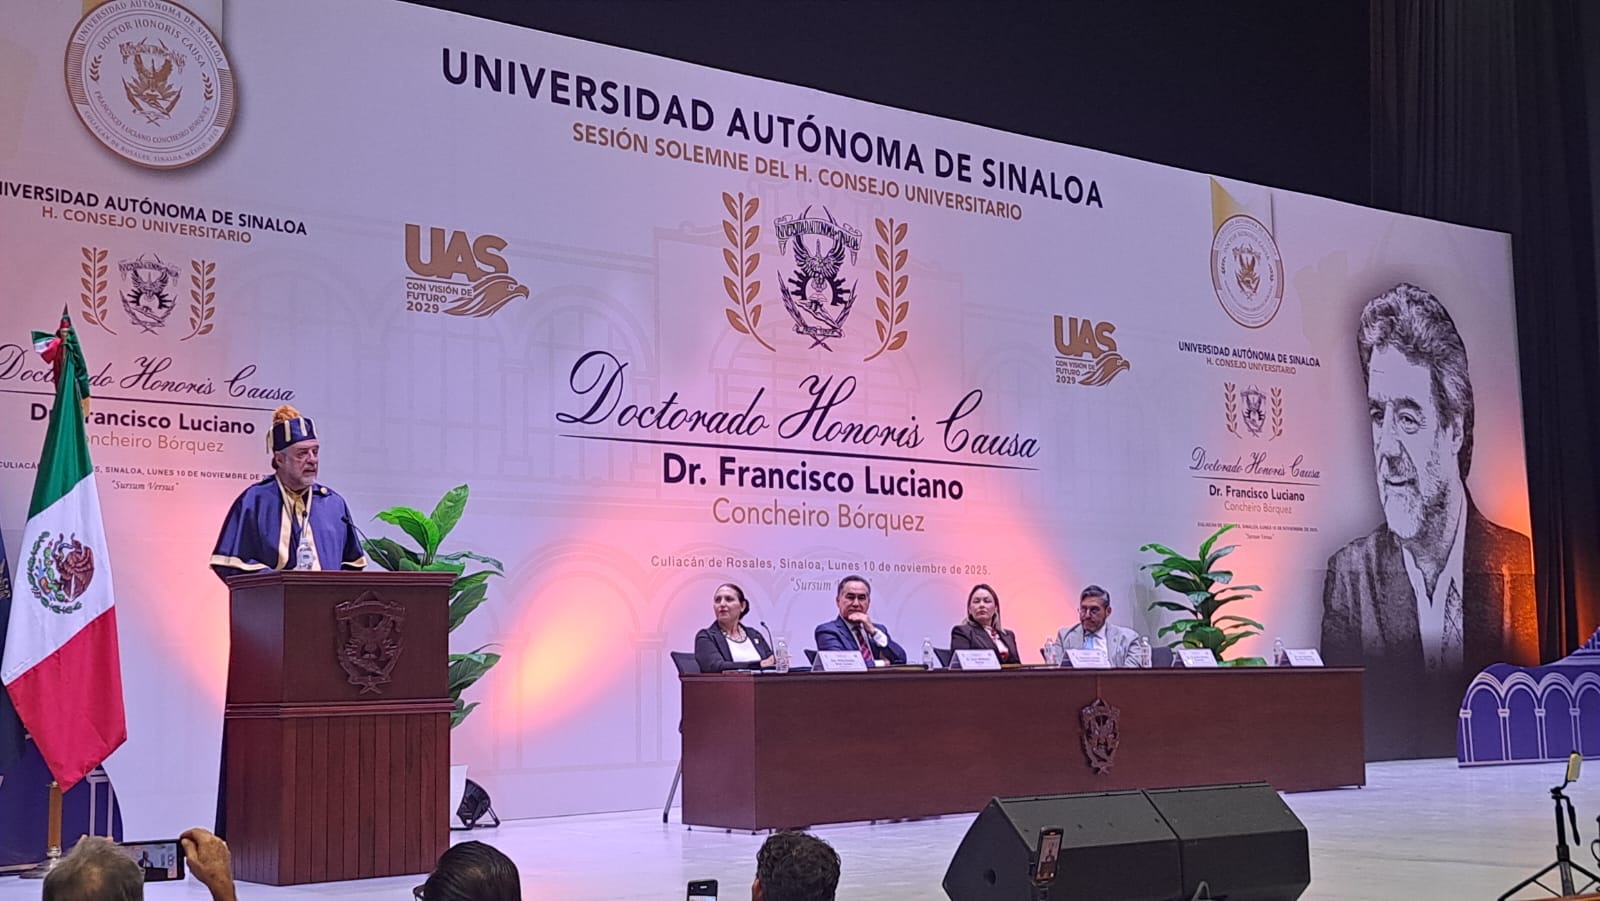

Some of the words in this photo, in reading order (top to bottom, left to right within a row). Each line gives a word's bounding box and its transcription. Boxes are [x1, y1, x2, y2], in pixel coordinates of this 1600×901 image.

[184, 16, 196, 27] DE
[98, 22, 132, 50] DOCTOR
[134, 19, 181, 39] HONORIS
[181, 37, 206, 68] CAUSA
[442, 47, 714, 132] UNIVERSIDAD
[726, 107, 925, 175] AUTÓNOMA
[935, 148, 972, 183] DE
[982, 158, 1104, 209] SINALOA
[572, 122, 649, 154] SESIÓN
[655, 138, 749, 172] SOLEMNE
[755, 156, 790, 180] DEL
[795, 164, 813, 183] H.
[818, 168, 900, 198] CONSEJO
[904, 184, 1023, 221] UNIVERSITARIO
[0, 181, 100, 207] IVERSIDAD
[104, 195, 207, 223] AUTÓNOMA
[212, 210, 233, 226] DE
[238, 213, 307, 236] SINALOA
[42, 206, 58, 219] H.
[63, 208, 137, 229] CONSEJO
[142, 218, 252, 244] UNIVERSITARIO
[405, 223, 509, 283] UAS
[406, 281, 427, 291] CON
[428, 283, 459, 295] VISIÓN
[461, 288, 473, 297] DE
[406, 291, 447, 304] FUTURO
[406, 301, 440, 314] 2029
[1054, 315, 1117, 359] UAS
[1178, 341, 1230, 357] UNIVERSIDAD
[1232, 347, 1276, 362] AUTÓNOMA
[1277, 353, 1288, 364] DE
[1289, 354, 1320, 368] SINALOA
[1215, 358, 1247, 369] CONSEJO
[1248, 362, 1296, 375] UNIVERSITARIO
[0, 344, 114, 387] Doctdo
[120, 356, 216, 394] Honoris
[224, 364, 296, 401] Causa
[1056, 367, 1081, 376] FUTURO
[556, 350, 770, 436] Doctorado
[778, 374, 925, 449] Honoris
[936, 389, 1041, 458] Causa
[84, 408, 171, 429] rancisco
[179, 413, 255, 435] Luciano
[87, 431, 152, 449] ncheiro
[158, 433, 224, 454] Bórquez
[147, 468, 174, 476] LUNES
[188, 470, 198, 478] DE
[200, 471, 247, 480] NOVIEMBRE
[1189, 446, 1243, 473] Doctorado
[1245, 452, 1285, 477] Honoris
[1289, 454, 1320, 479] Causa
[663, 453, 707, 486] Dr.
[719, 456, 855, 493] Francisco
[865, 465, 964, 500] Luciano
[1209, 484, 1223, 497] Dr.
[1226, 485, 1269, 500] Francisco
[1271, 488, 1305, 501] Luciano
[712, 497, 830, 528] Concheiro
[837, 502, 925, 537] Bórquez
[1224, 500, 1261, 513] Concheiro
[651, 555, 705, 568] Culiacán
[708, 557, 722, 568] de
[726, 557, 776, 571] Rosales,
[779, 558, 825, 571] Sinaloa,
[828, 560, 860, 571] Lunes
[863, 561, 875, 572] 10
[878, 561, 891, 572] de
[894, 563, 947, 574] noviembre
[950, 564, 962, 575] de
